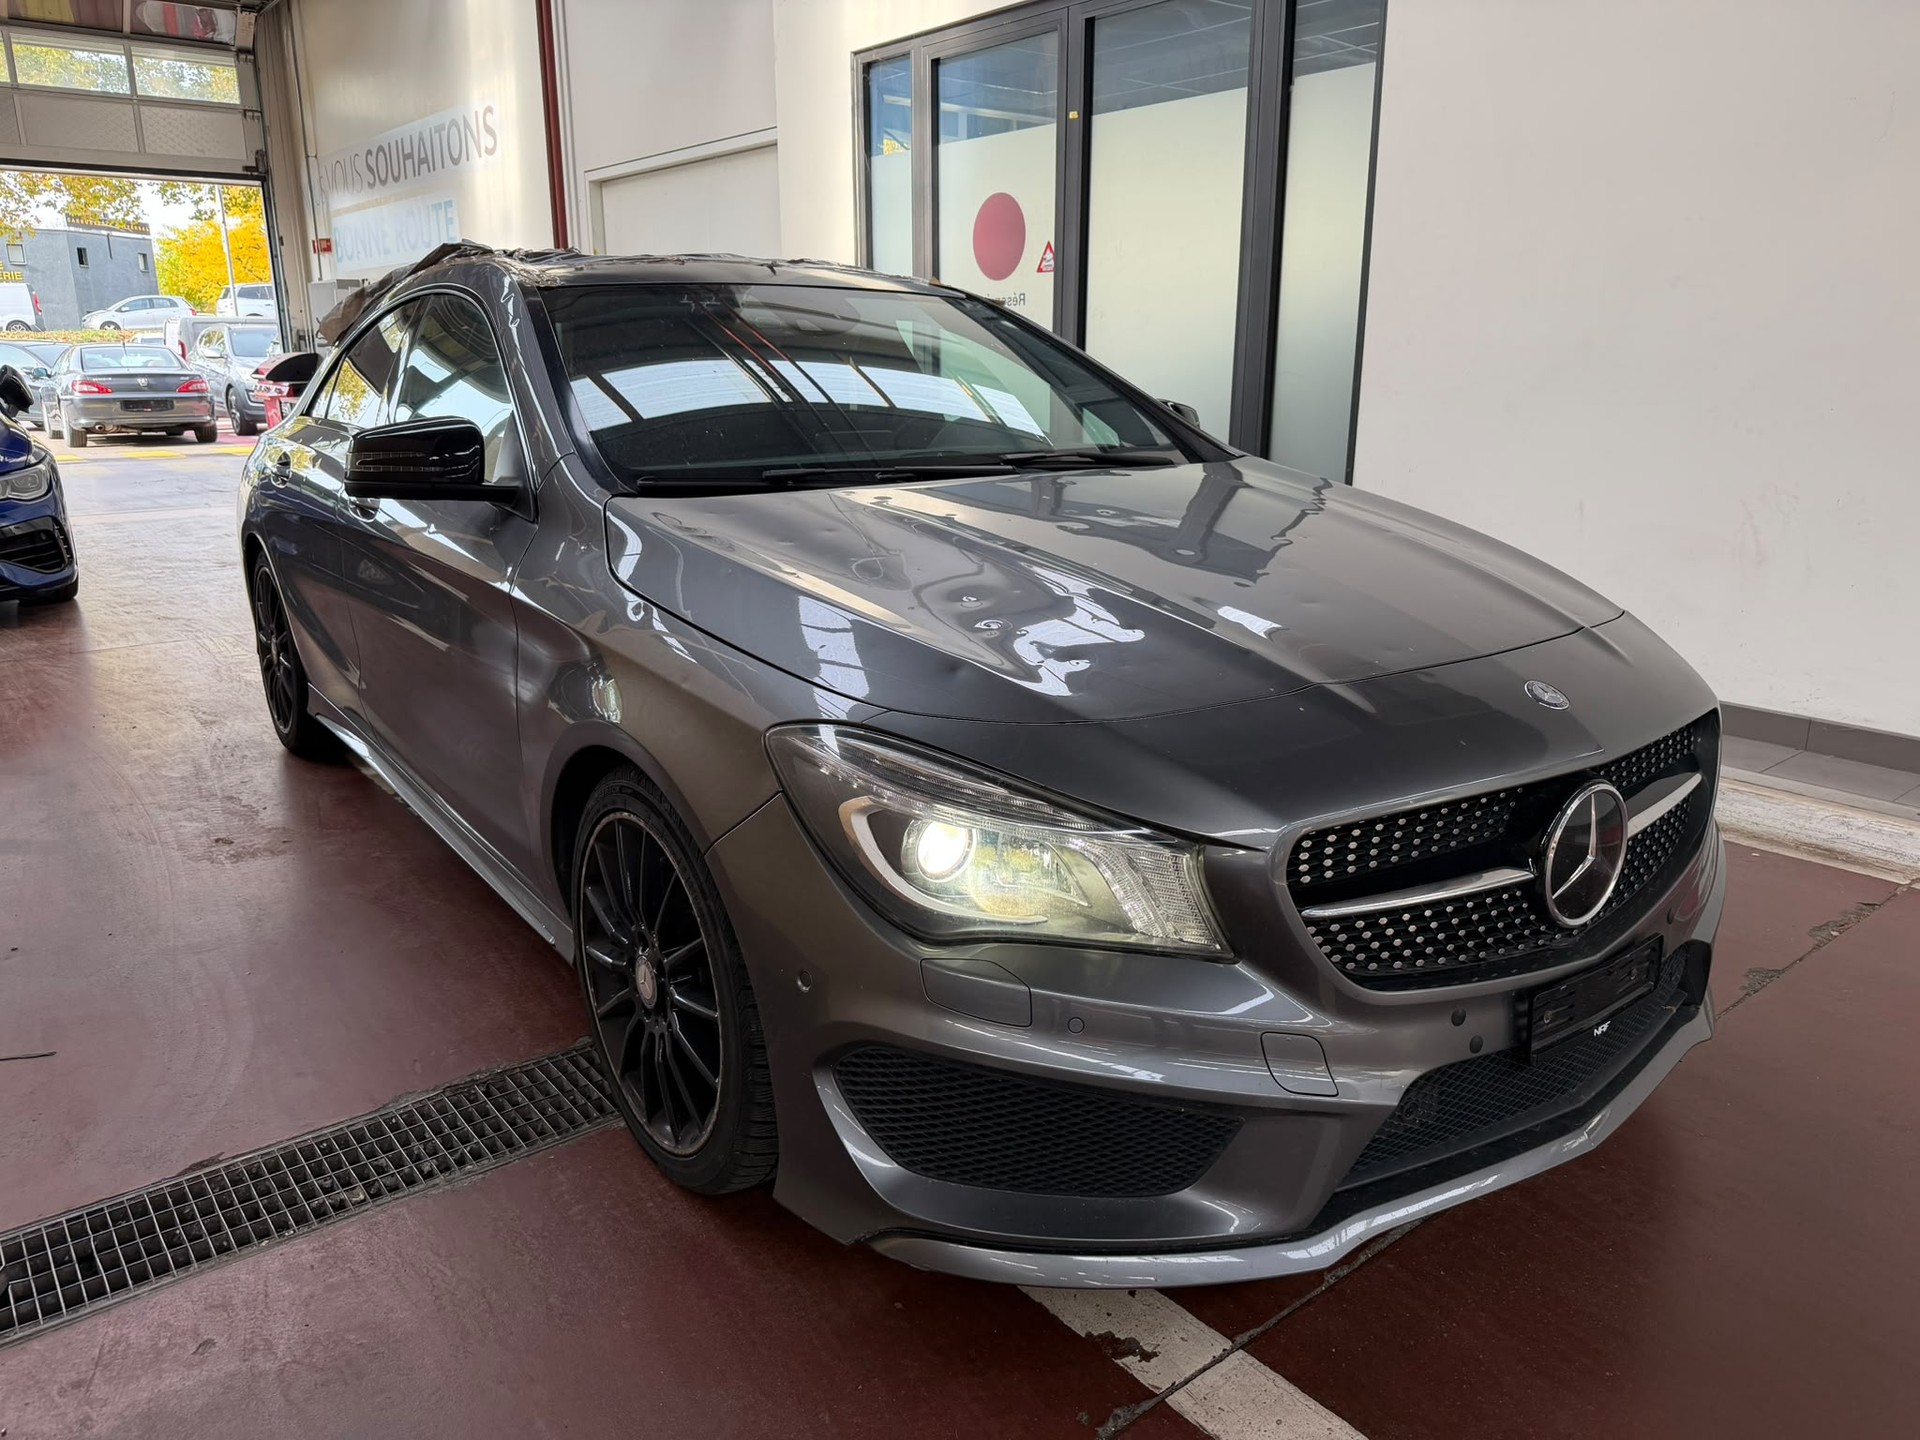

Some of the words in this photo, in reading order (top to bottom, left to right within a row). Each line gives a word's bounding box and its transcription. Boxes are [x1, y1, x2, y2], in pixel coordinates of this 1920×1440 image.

[324, 153, 363, 194] VOUS
[365, 105, 498, 189] SOUHAITONS
[334, 217, 390, 263] BONNE
[395, 199, 457, 254] ROUTE
